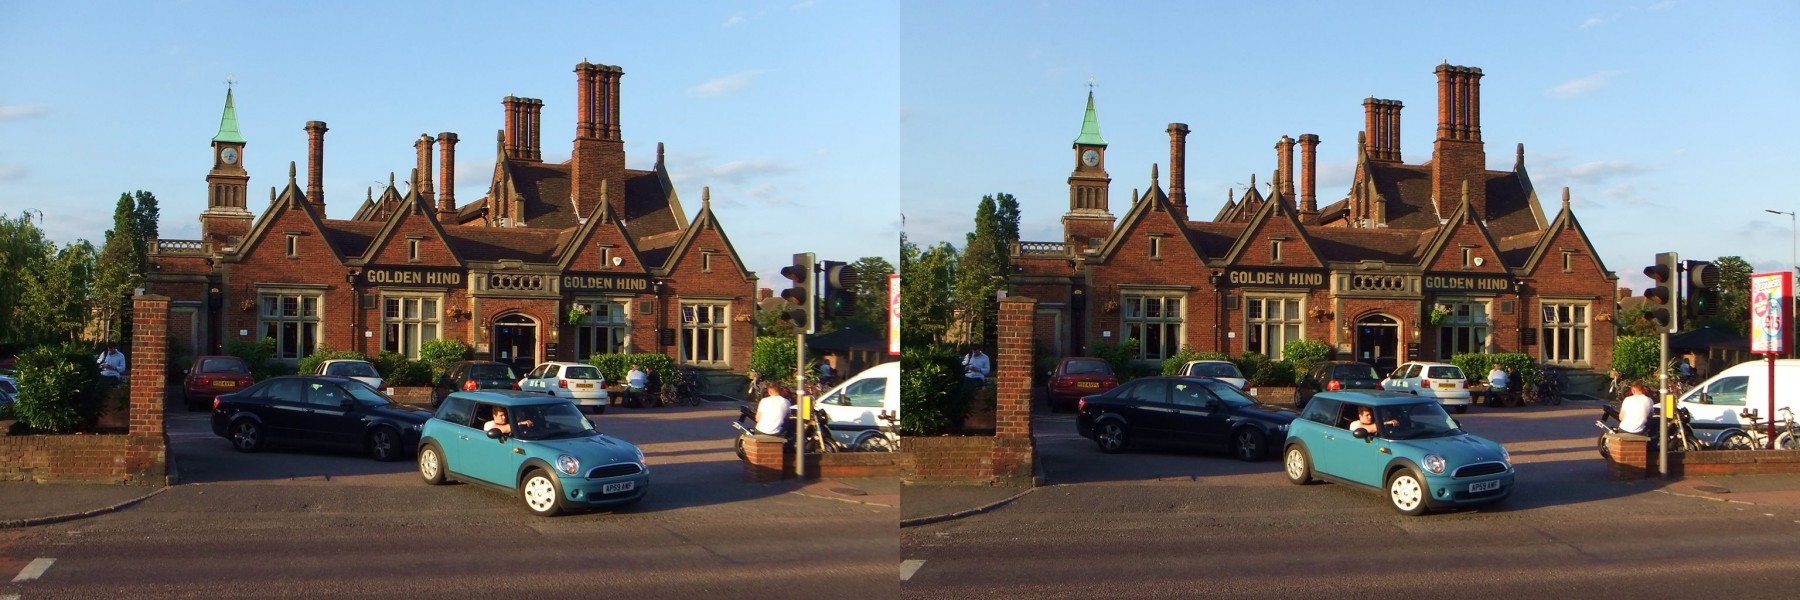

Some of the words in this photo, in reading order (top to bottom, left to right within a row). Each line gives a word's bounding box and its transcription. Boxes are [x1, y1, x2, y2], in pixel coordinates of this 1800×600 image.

[367, 270, 421, 284] GOLDEN
[426, 272, 460, 284] HIND
[564, 276, 612, 289] GOLDEN
[616, 278, 647, 290] HIND
[1230, 270, 1284, 284] GOLDEN
[1289, 272, 1322, 286] HIND
[1425, 276, 1474, 290] GOLDEN
[1478, 278, 1508, 290] HIND
[1764, 315, 1780, 330] £15
